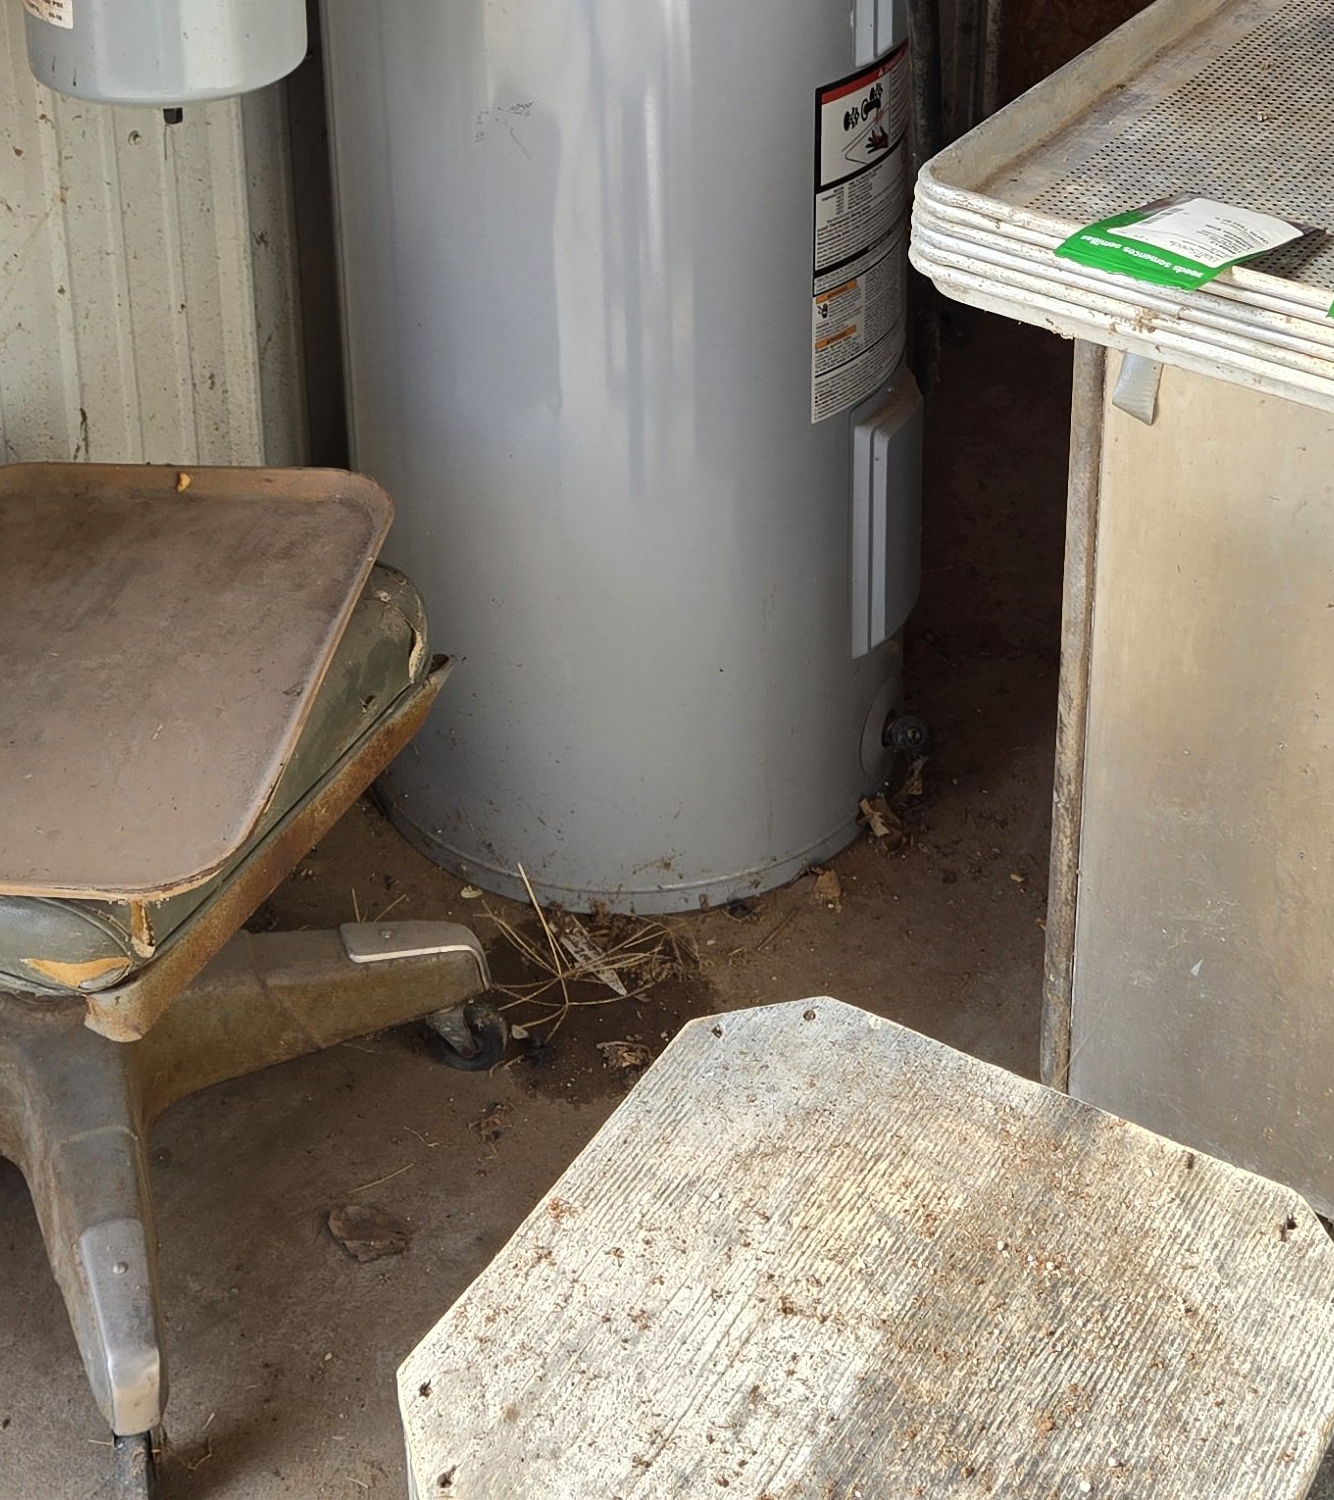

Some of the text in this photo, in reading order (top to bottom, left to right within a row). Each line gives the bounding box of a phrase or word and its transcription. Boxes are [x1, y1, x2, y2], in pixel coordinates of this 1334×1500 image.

[1080, 234, 1204, 279] seeds semences semillas
